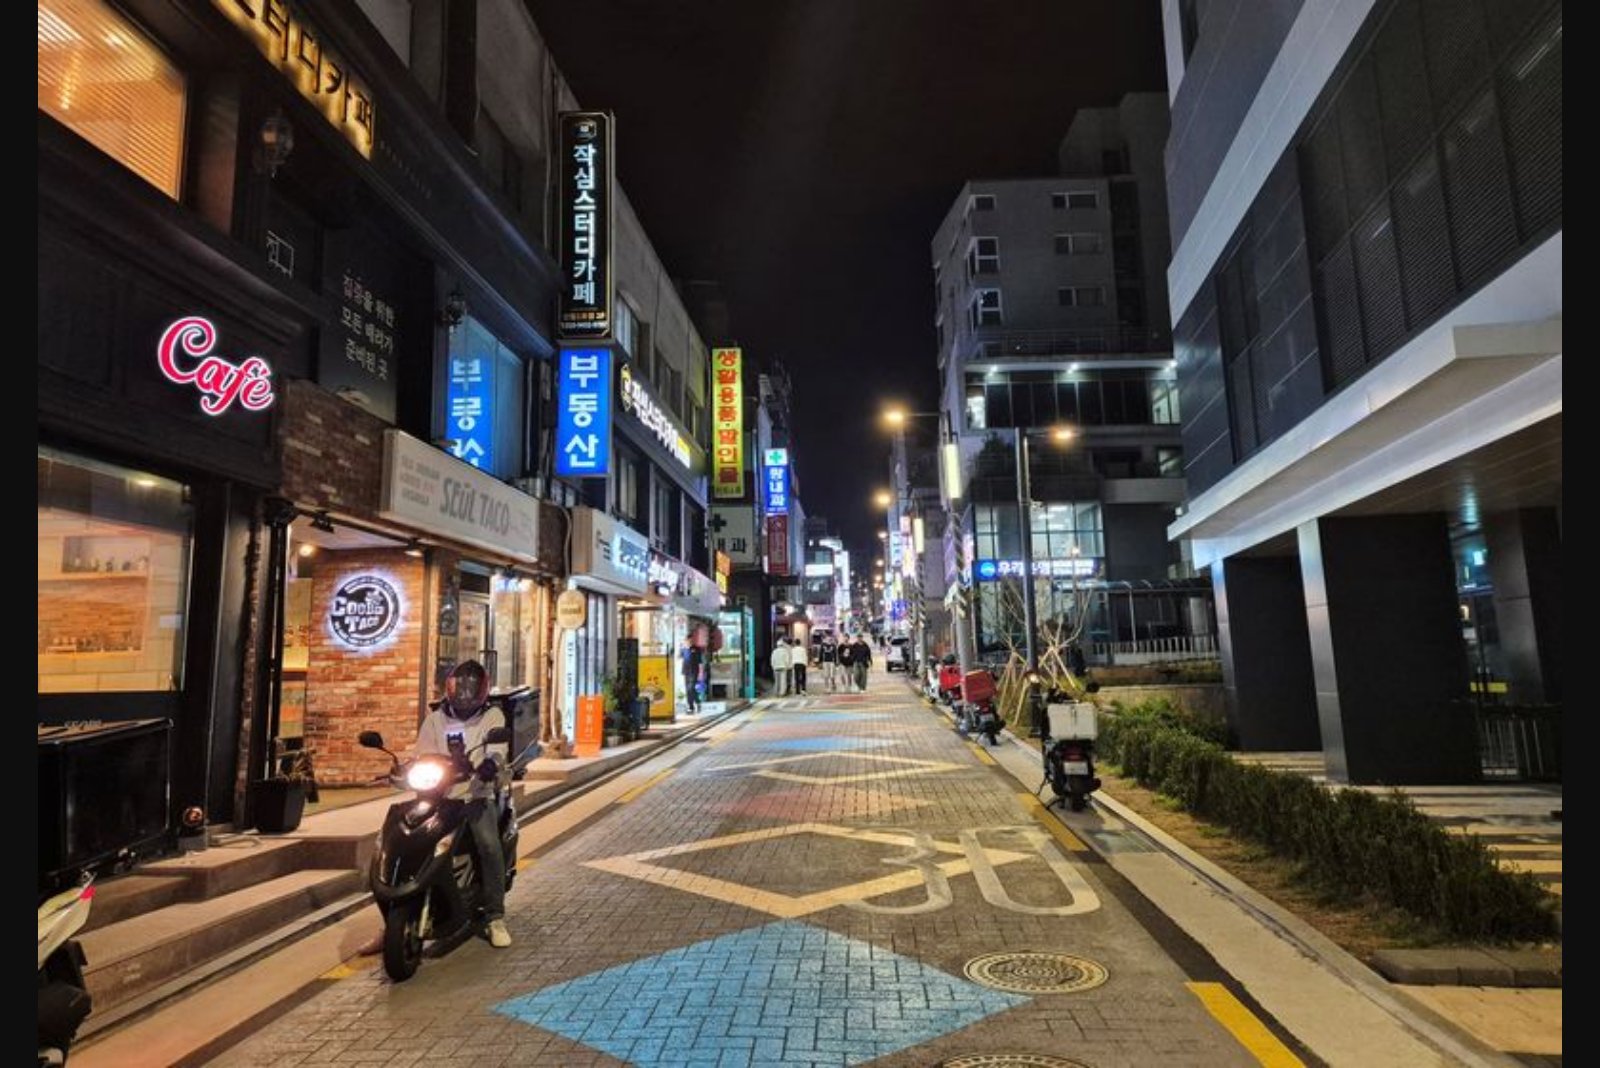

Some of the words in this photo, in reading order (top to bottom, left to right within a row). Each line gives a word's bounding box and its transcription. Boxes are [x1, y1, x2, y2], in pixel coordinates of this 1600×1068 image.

[573, 143, 597, 305] 작심스터디카페
[564, 355, 600, 468] 부동산
[842, 825, 1101, 916] 30
